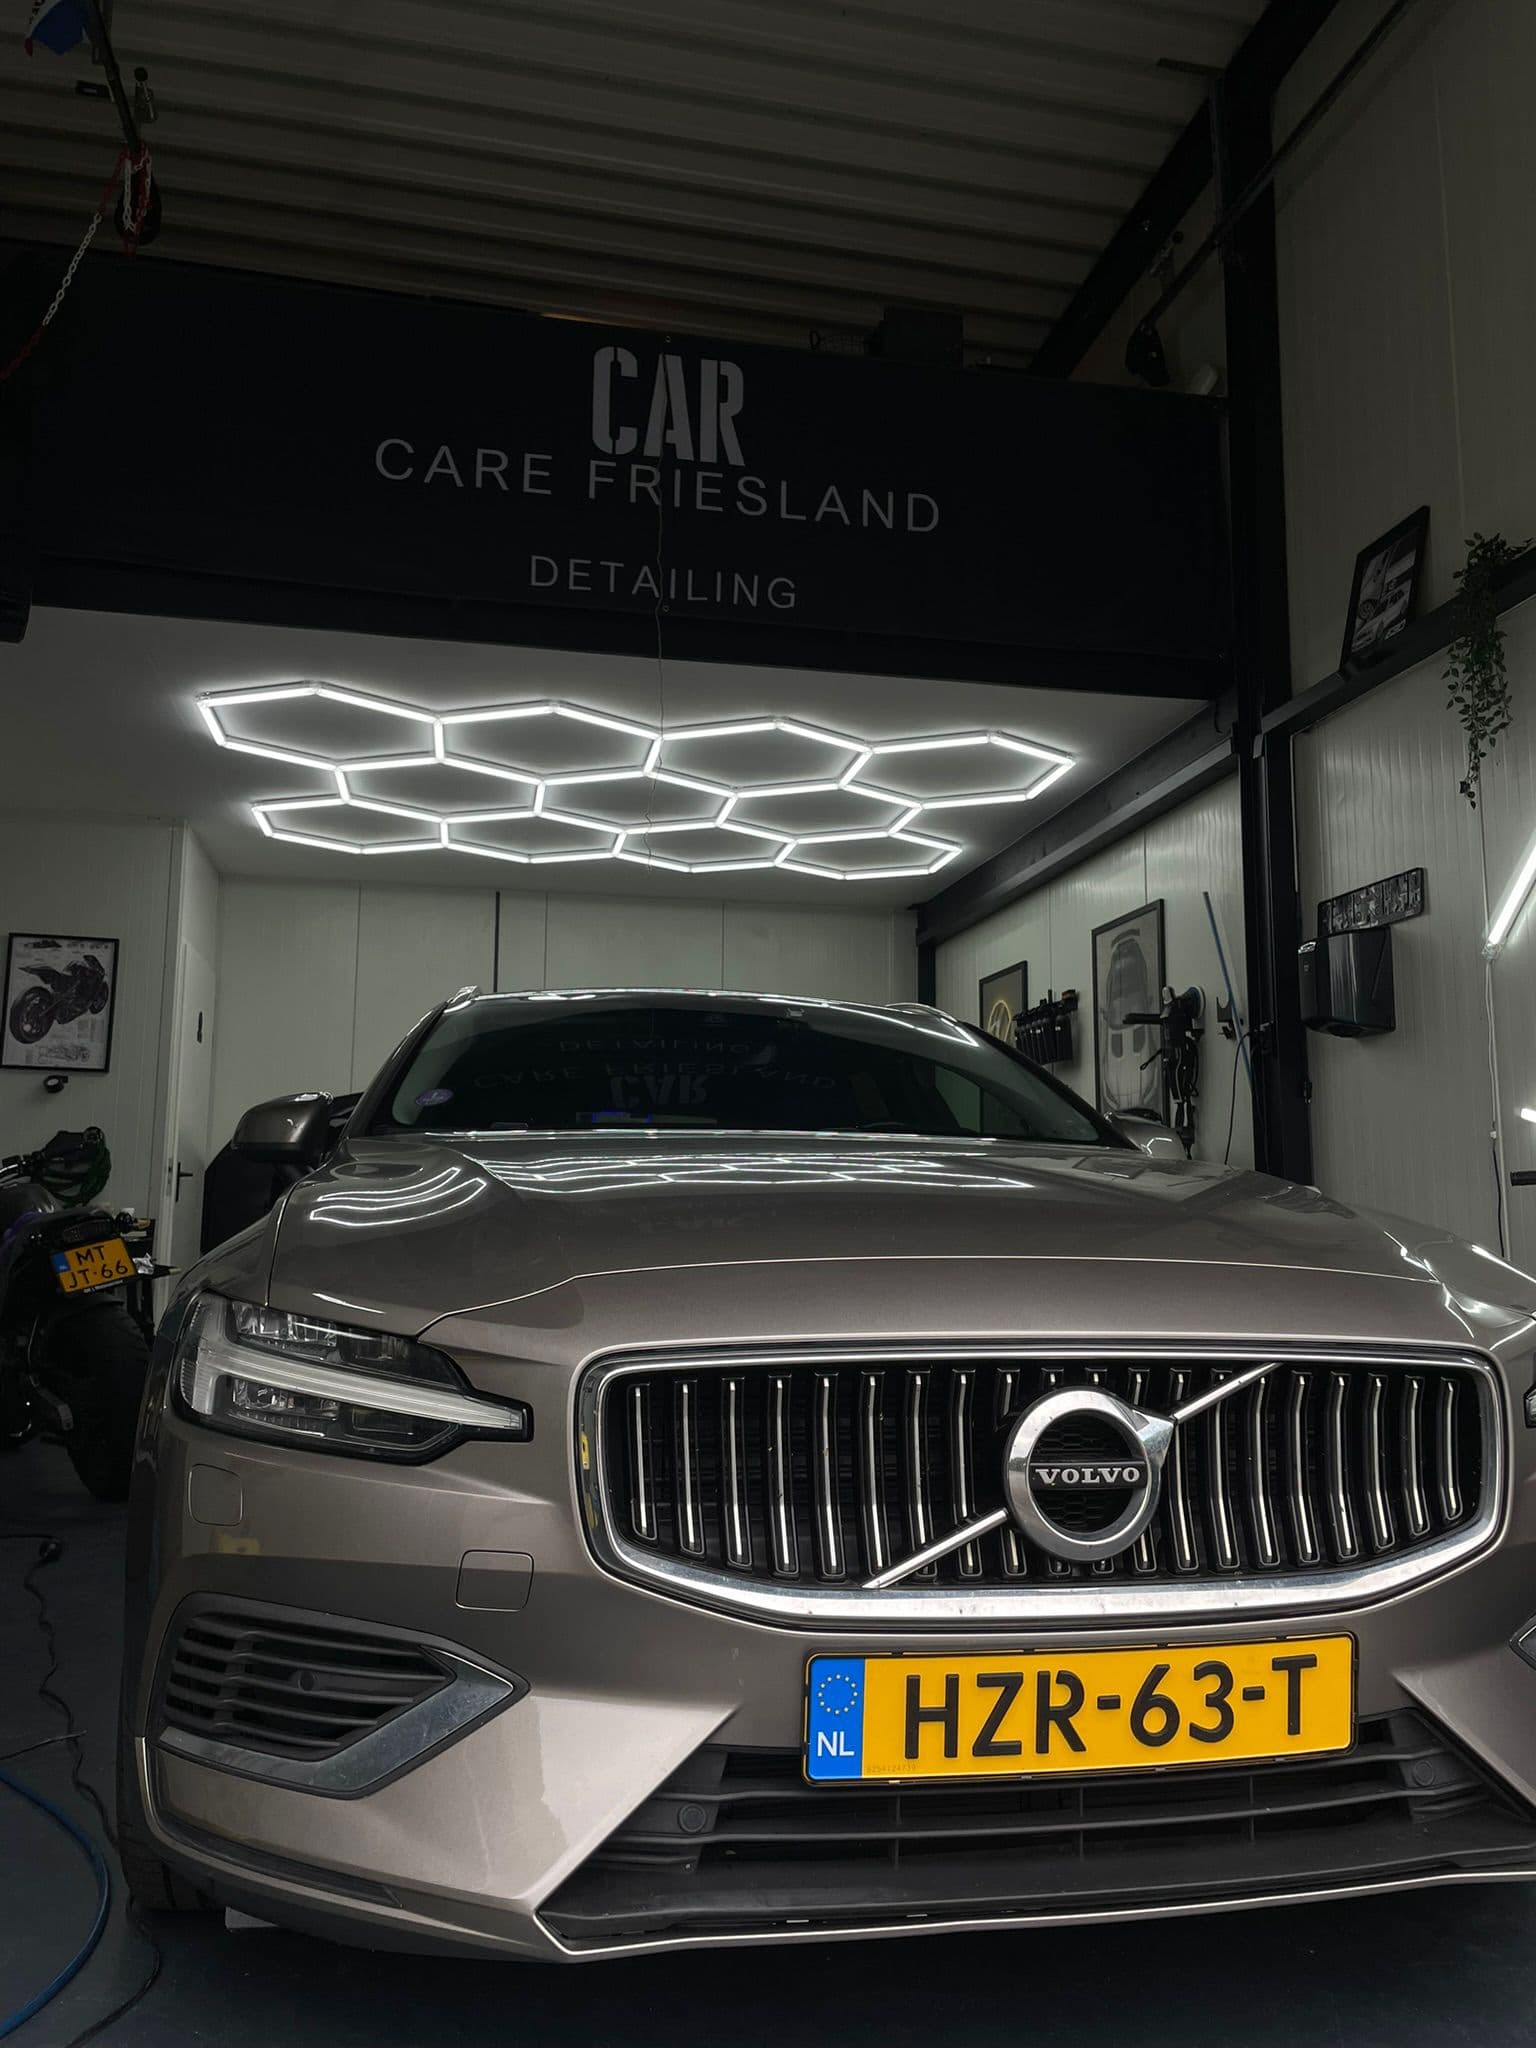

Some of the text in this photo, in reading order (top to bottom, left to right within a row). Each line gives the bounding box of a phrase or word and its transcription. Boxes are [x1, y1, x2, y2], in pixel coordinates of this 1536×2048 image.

[591, 346, 746, 467] CAR
[375, 438, 940, 533] CARE FRIESLAND
[530, 555, 797, 609] DETAILING
[75, 1245, 105, 1266] MT
[1035, 1467, 1140, 1484] VOLVO
[903, 1653, 1318, 1760] HZR-63-T
[816, 1731, 855, 1758] NL
